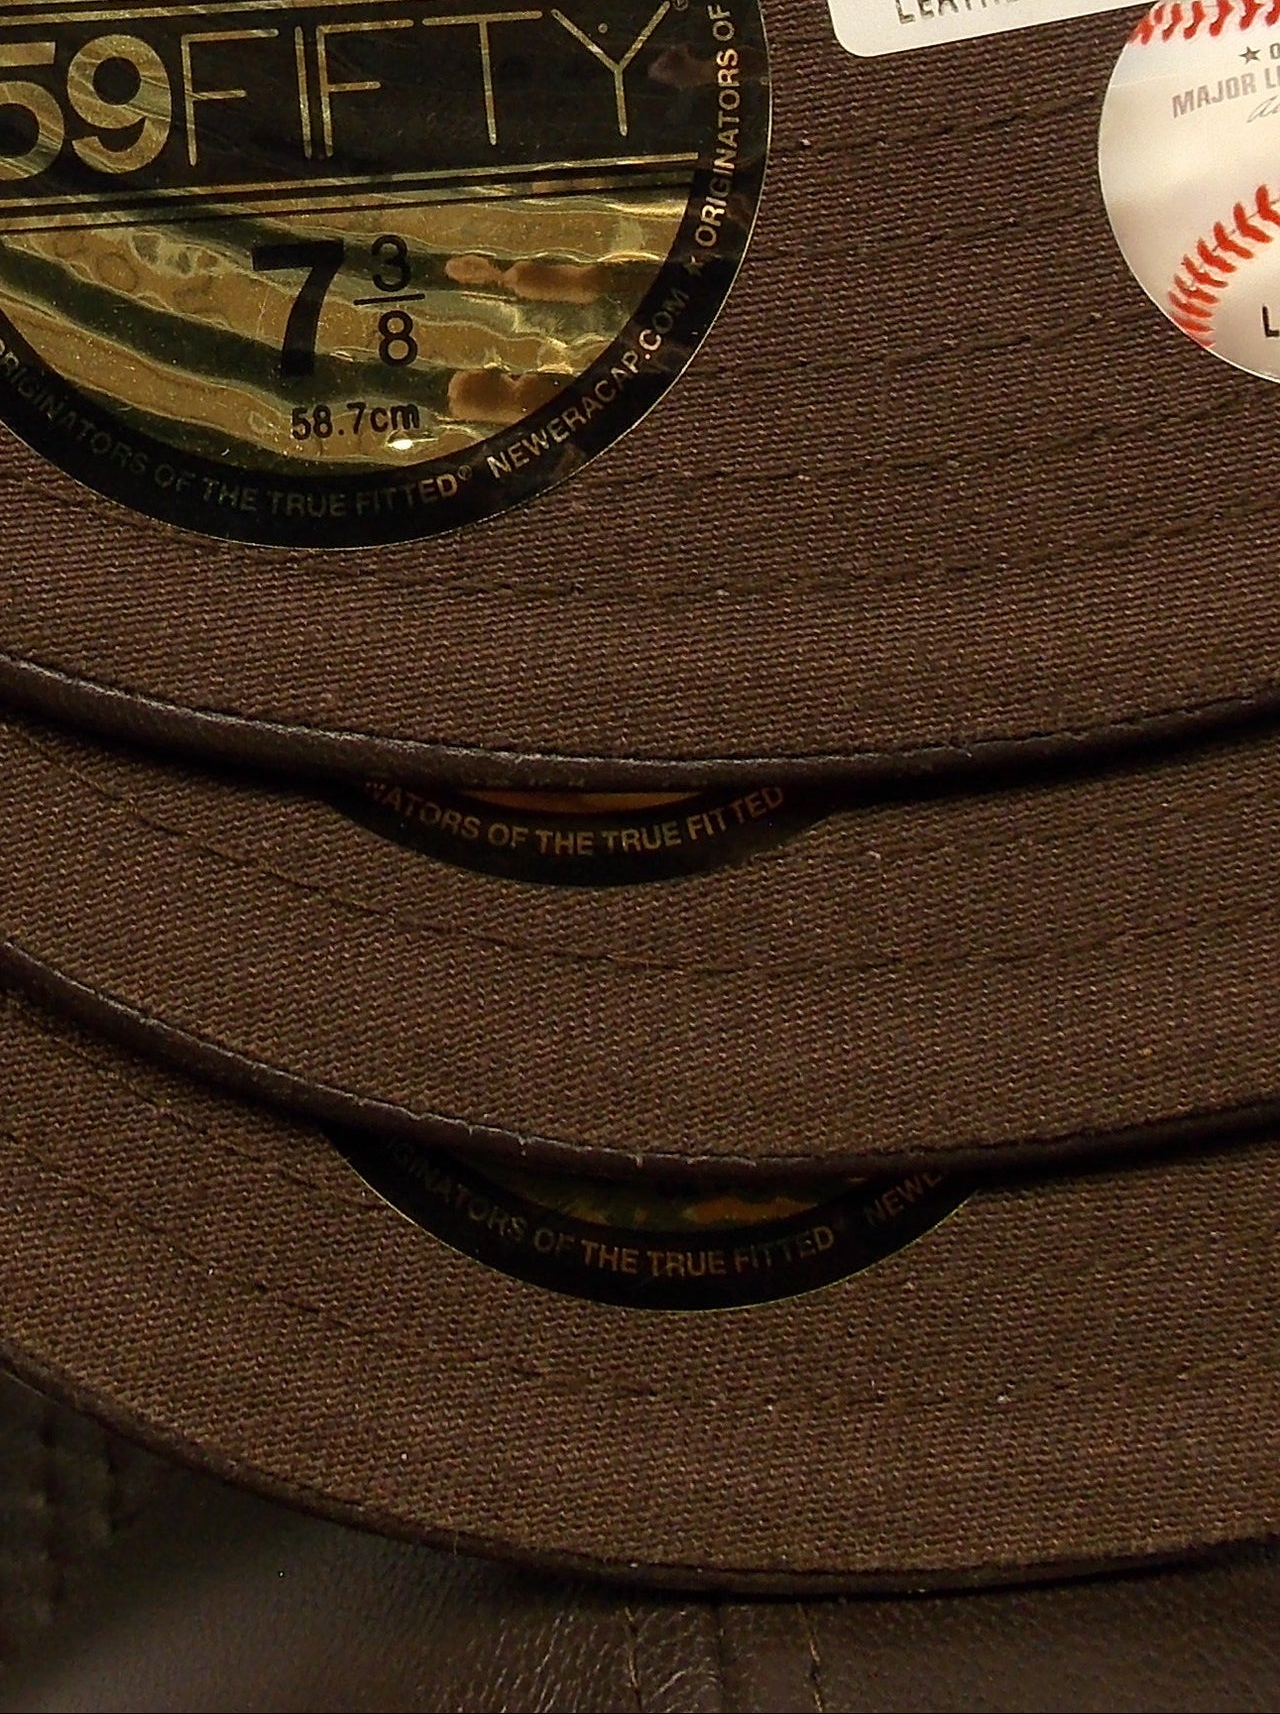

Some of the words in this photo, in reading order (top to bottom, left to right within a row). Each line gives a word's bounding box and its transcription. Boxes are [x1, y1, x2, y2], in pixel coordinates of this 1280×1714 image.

[706, 2, 737, 43] OF
[1172, 72, 1256, 118] MAJOR
[694, 48, 739, 248] ORIGINATORS
[252, 239, 344, 377] 7
[371, 234, 412, 293] 3
[378, 310, 418, 369] 8
[291, 402, 420, 441] 58.7cm
[200, 476, 258, 513] THE
[270, 492, 347, 519] TRUE
[486, 822, 528, 848] OF
[535, 829, 593, 857] THE
[602, 820, 682, 855] TRUE
[687, 785, 785, 842] FITTED
[580, 1238, 640, 1276] THE
[647, 1250, 726, 1278] TRUE
